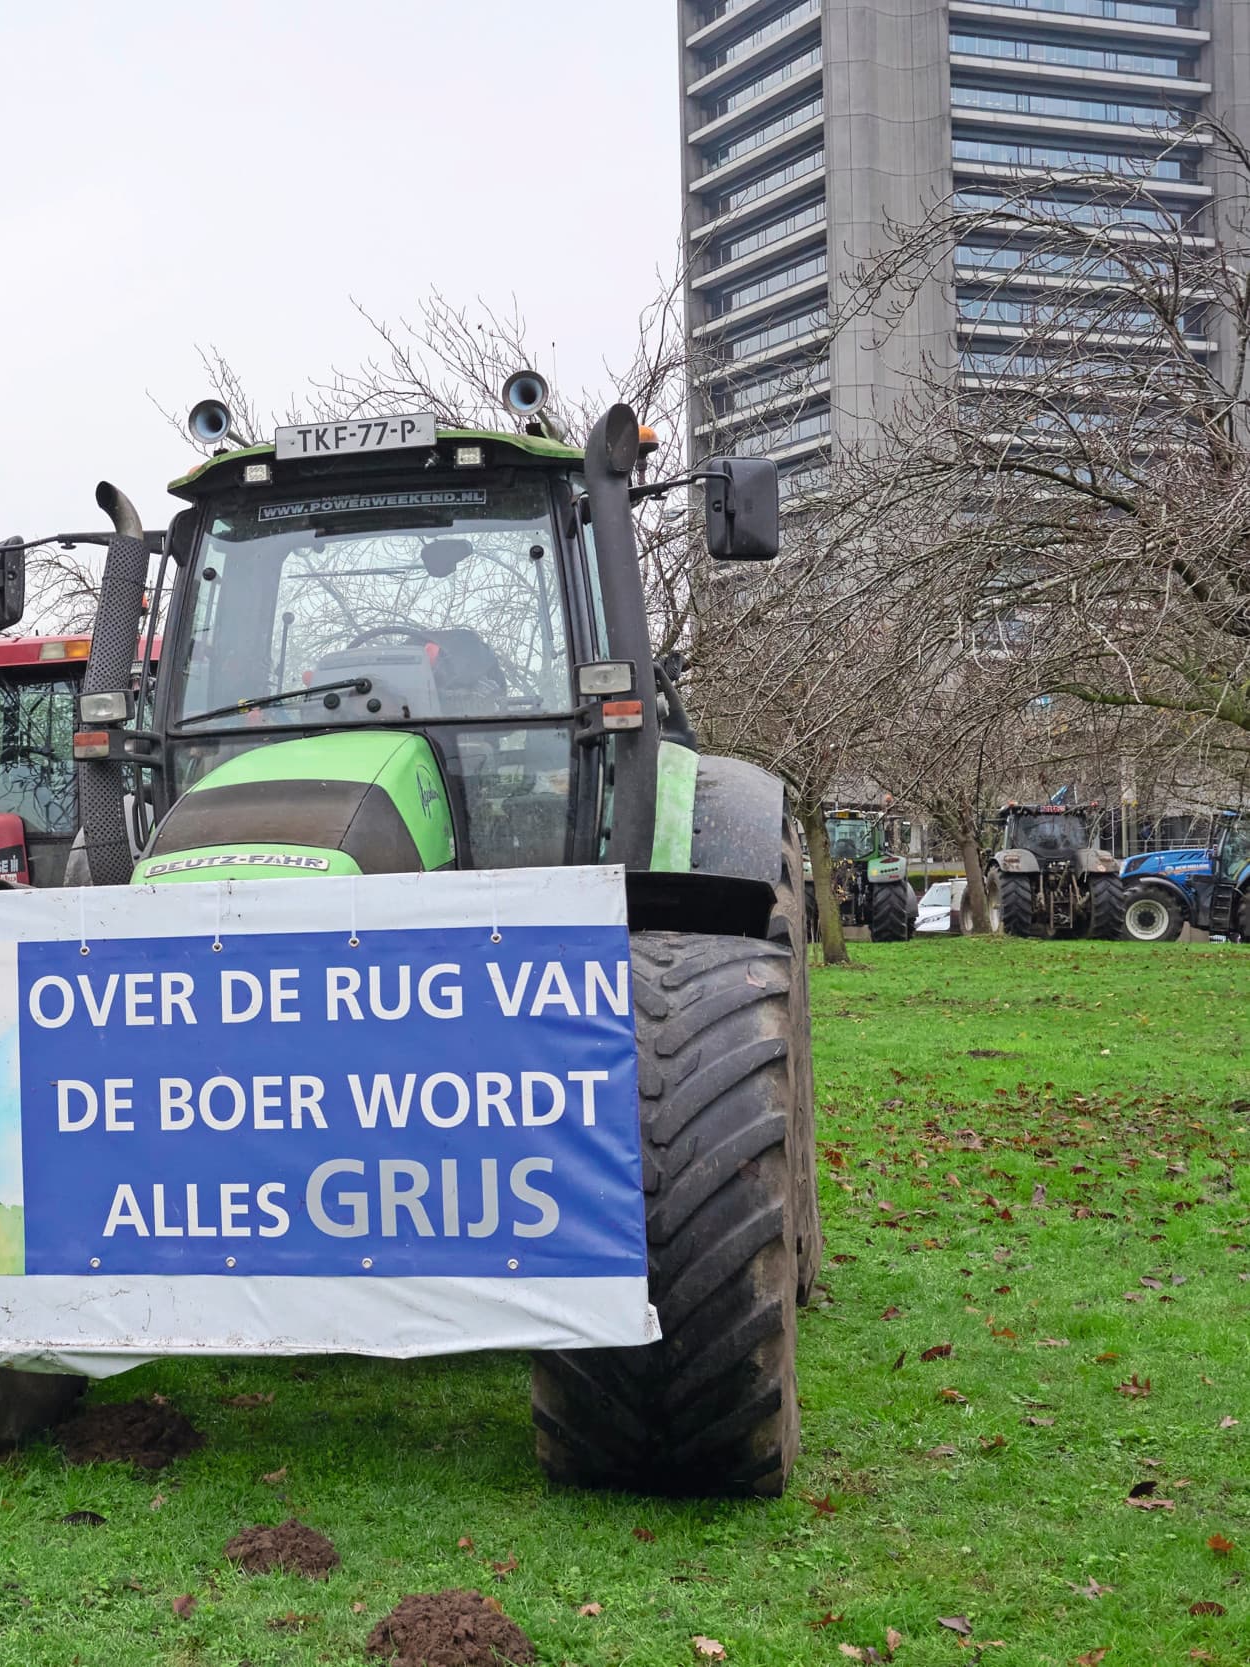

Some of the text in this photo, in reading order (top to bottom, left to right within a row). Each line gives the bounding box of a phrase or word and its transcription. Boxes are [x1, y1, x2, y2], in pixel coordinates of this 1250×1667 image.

[297, 419, 416, 453] TKF-77-P
[263, 491, 483, 518] WWW.POWERWEEKEND.NL
[149, 854, 322, 875] DEUTZ-FAHR
[28, 960, 630, 1029] OVER DE RUG VAN
[56, 1070, 609, 1133] DE BOER WORDT
[102, 1156, 562, 1240] ALLES GRIJS
